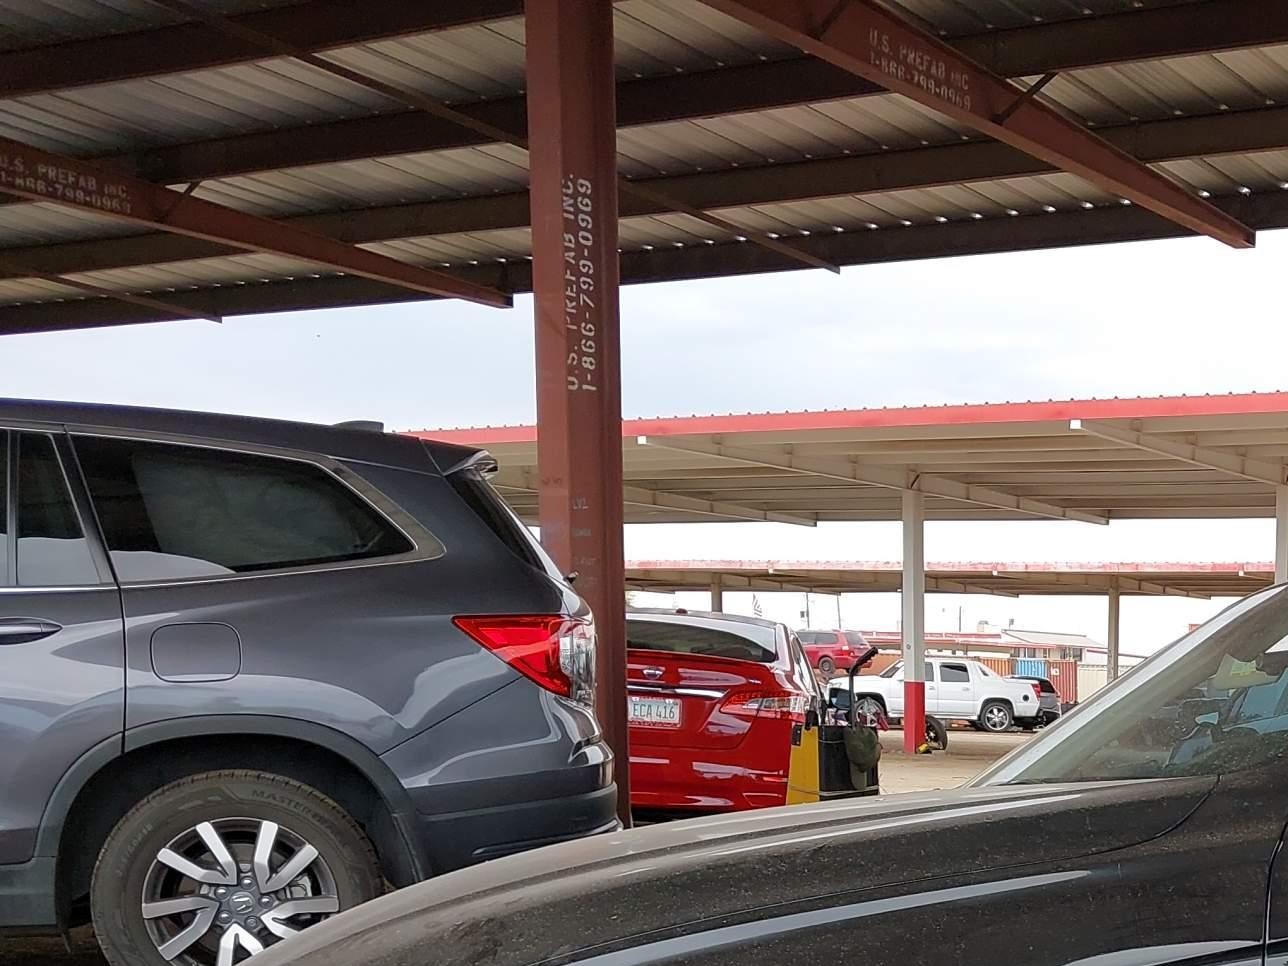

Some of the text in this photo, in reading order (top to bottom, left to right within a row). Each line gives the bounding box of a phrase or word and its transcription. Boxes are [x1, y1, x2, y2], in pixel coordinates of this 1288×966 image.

[37, 163, 98, 191] PREFAB
[576, 178, 598, 391] 1-866-799-0969
[633, 702, 676, 720] ECA 416
